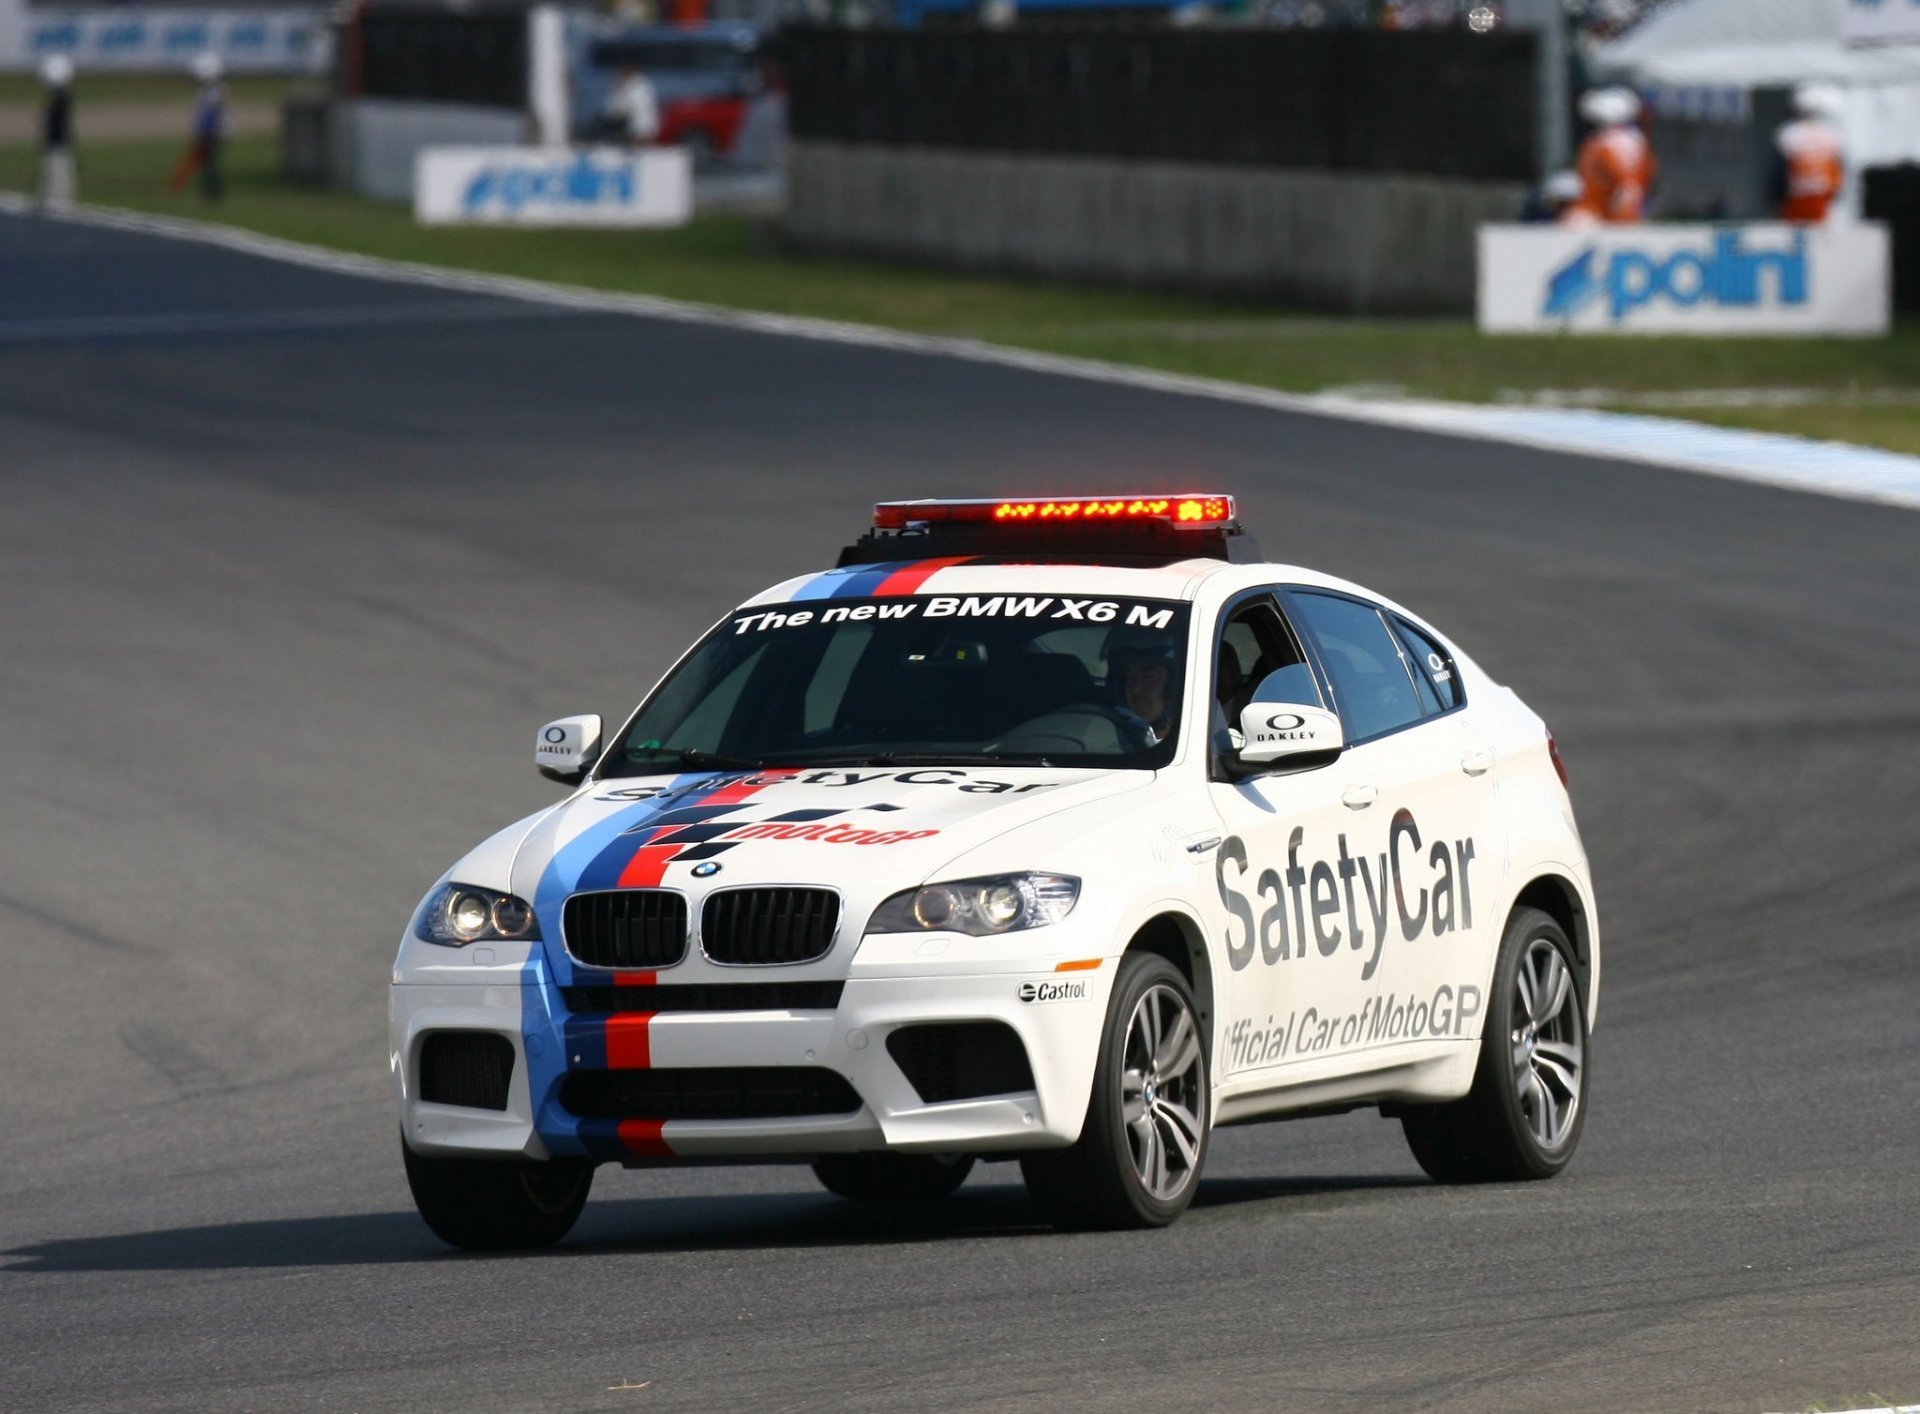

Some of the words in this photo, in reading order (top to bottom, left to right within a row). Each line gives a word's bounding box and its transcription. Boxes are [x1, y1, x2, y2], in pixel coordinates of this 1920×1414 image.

[1608, 232, 1809, 319] polini
[734, 612, 812, 635] The
[820, 603, 917, 624] new
[922, 596, 1054, 618] BMW
[1050, 599, 1117, 622] X6
[1125, 606, 1175, 630] M
[1257, 731, 1316, 742] OAKLEY
[1216, 807, 1475, 981] SafetyCar
[1038, 981, 1086, 1001] Castrol
[1295, 1007, 1342, 1055] Car
[1340, 996, 1373, 1046] of
[1366, 983, 1481, 1042] MotoGP
